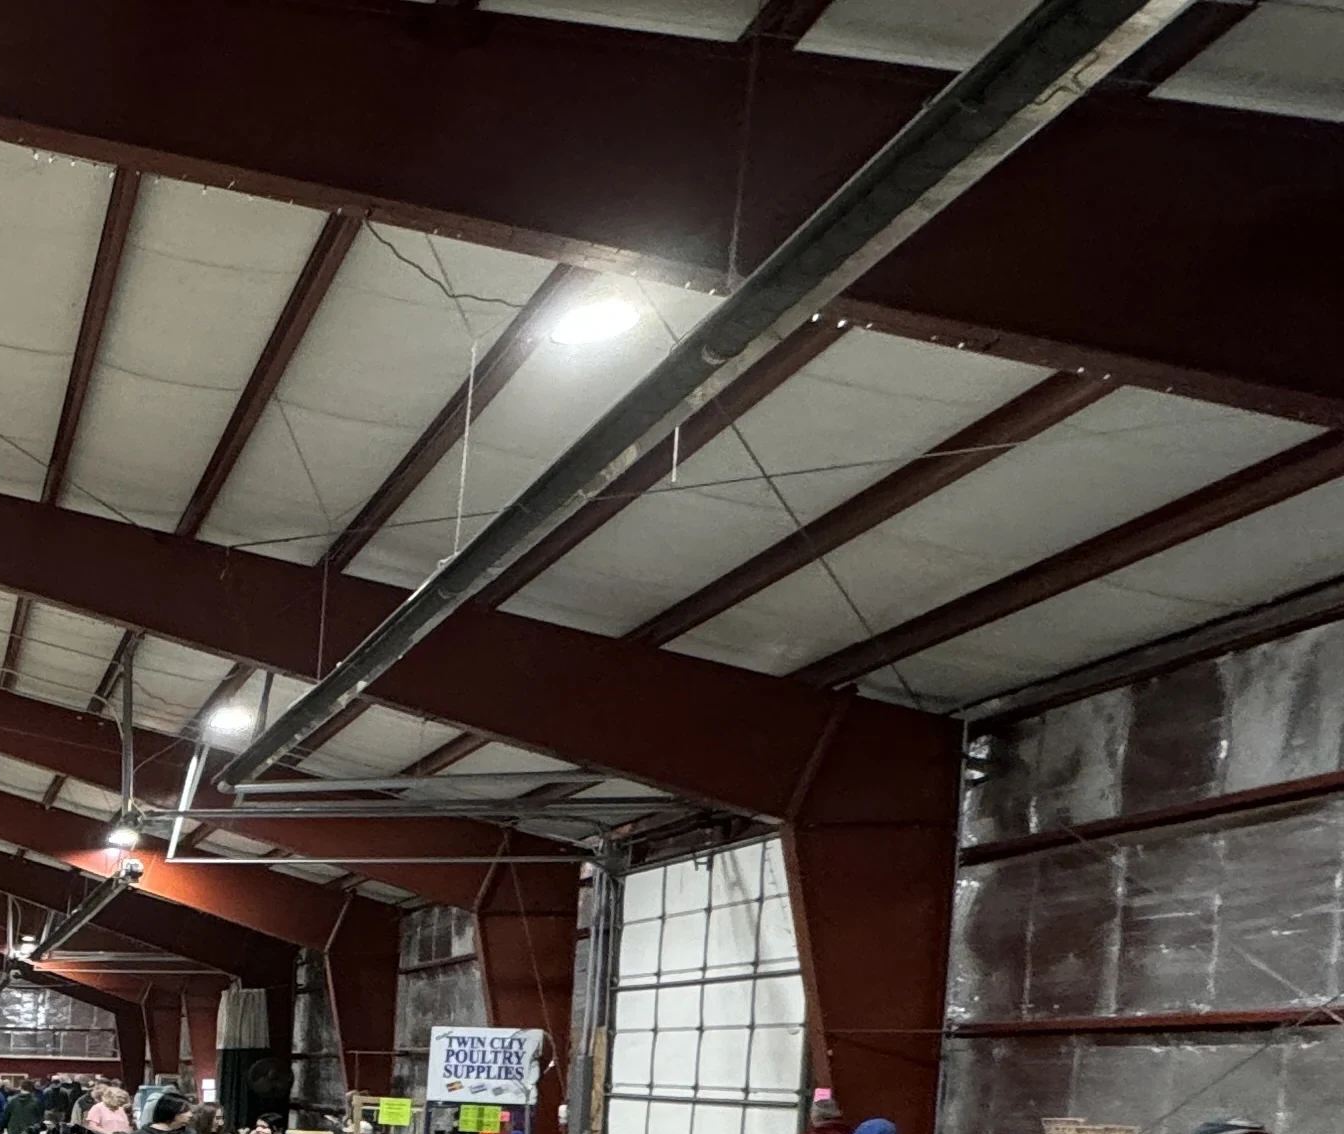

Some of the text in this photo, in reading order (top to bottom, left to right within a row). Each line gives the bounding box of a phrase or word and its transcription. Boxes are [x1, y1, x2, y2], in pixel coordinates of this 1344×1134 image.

[446, 1035, 527, 1050] TWIN CITY
[444, 1049, 527, 1065] POULTRY
[442, 1064, 525, 1081] SUPPLIES
